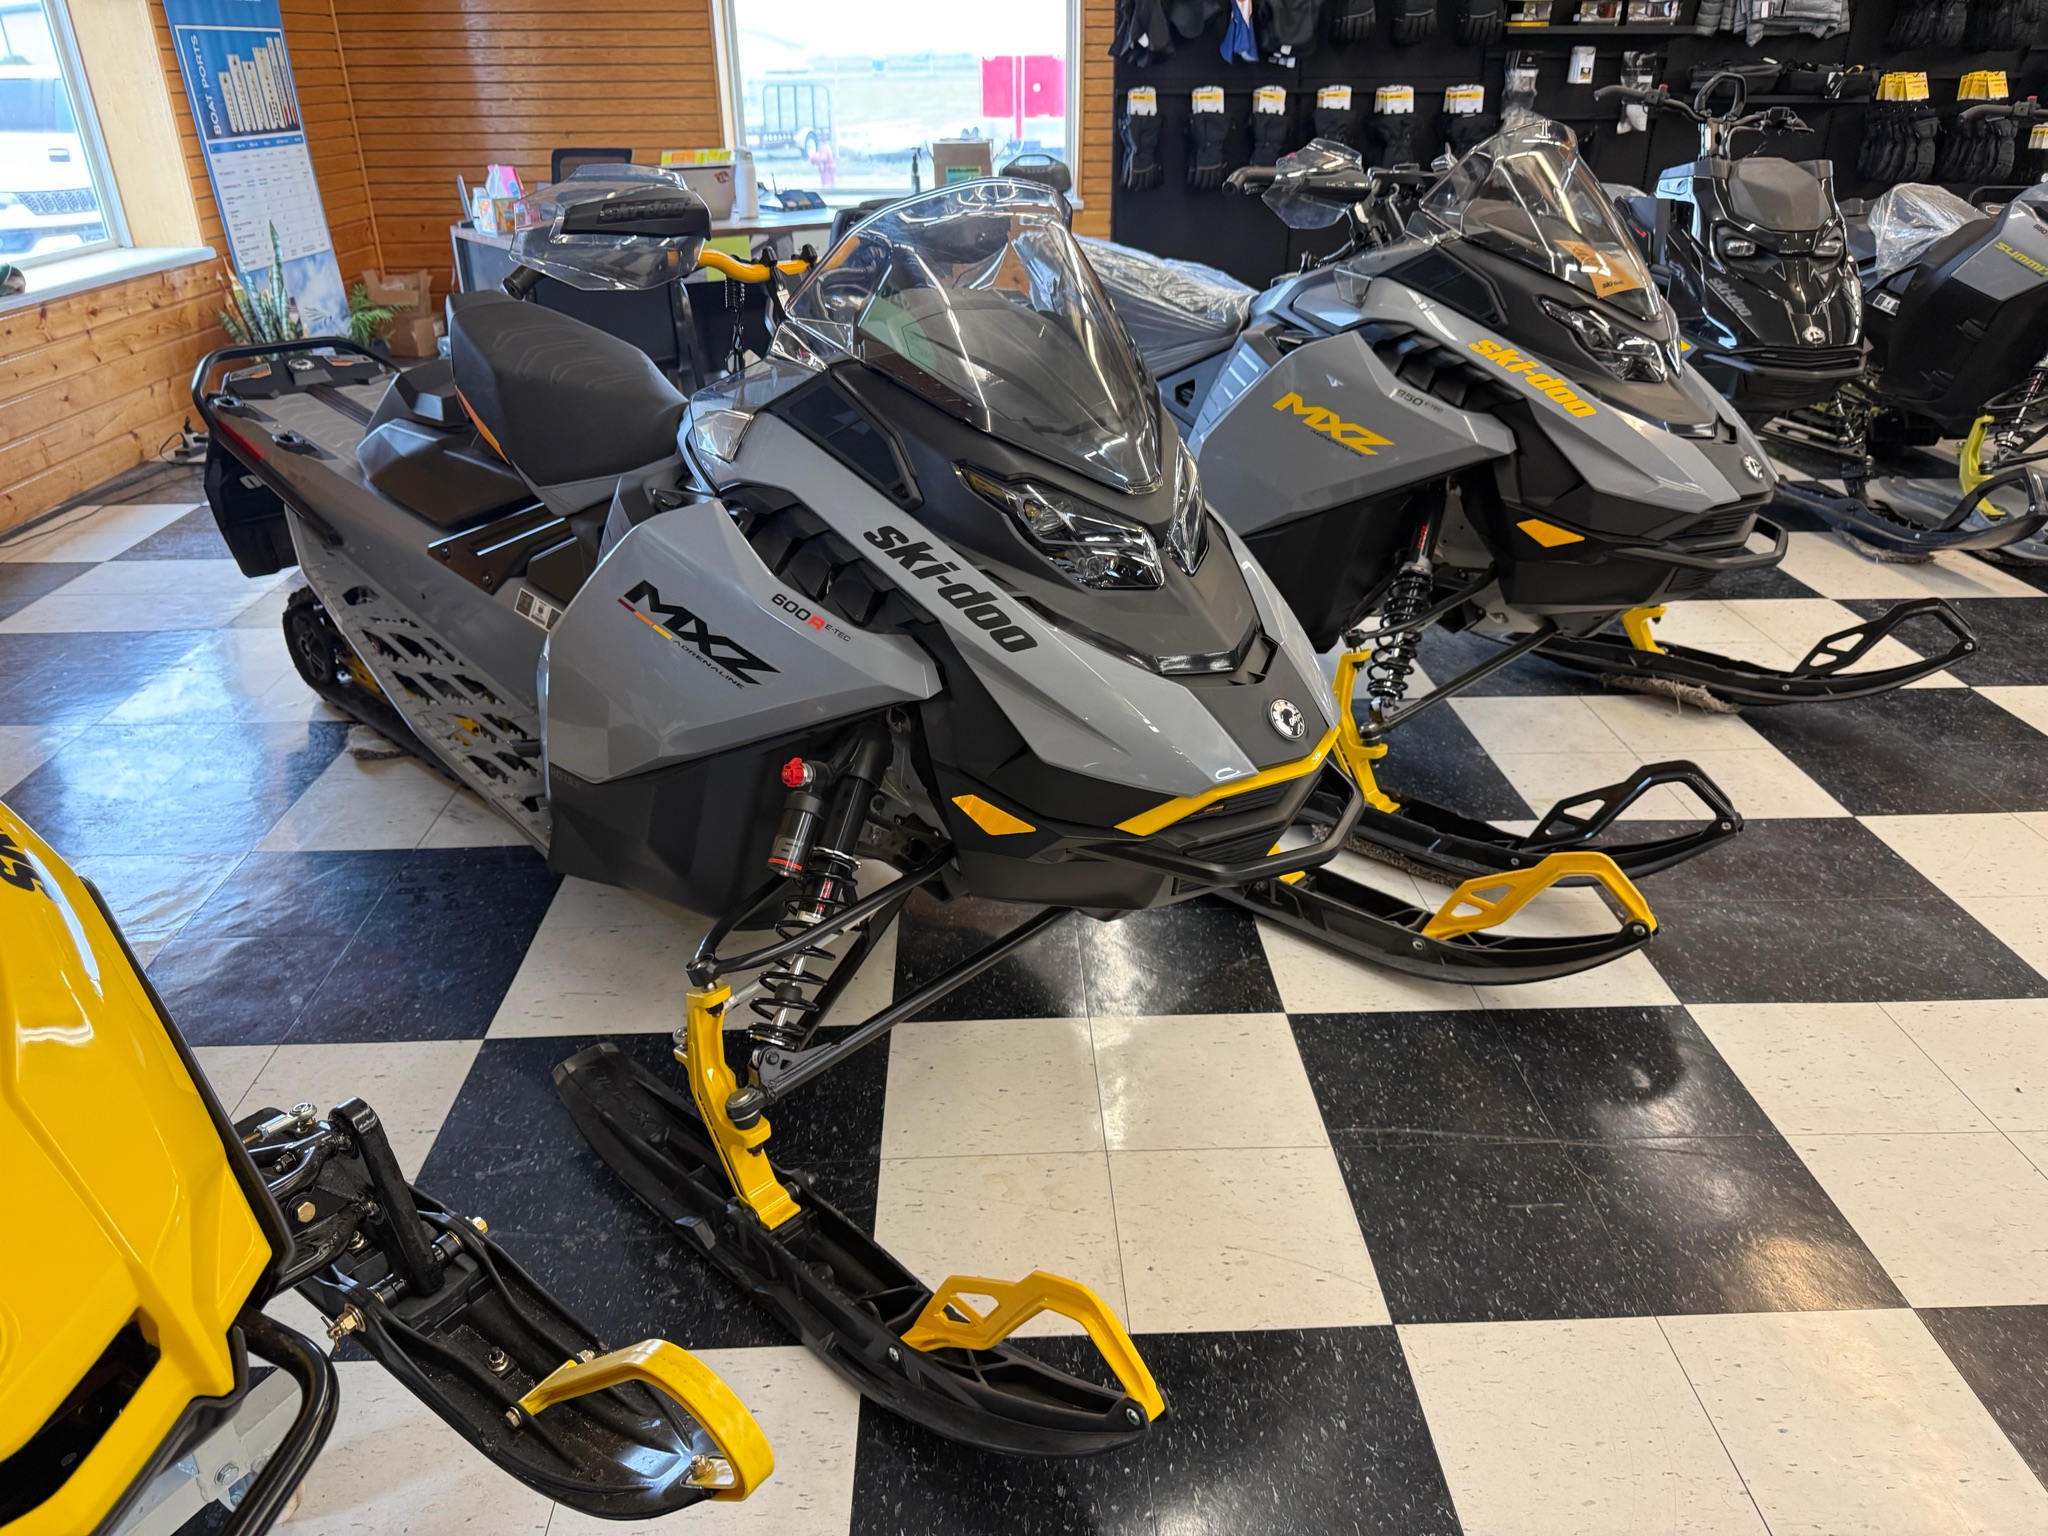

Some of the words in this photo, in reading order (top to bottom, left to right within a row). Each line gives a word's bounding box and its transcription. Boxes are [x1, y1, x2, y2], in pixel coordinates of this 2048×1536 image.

[190, 34, 211, 89] PORTS
[204, 93, 222, 135] BOAT
[1708, 277, 1752, 317] ski-doo
[1468, 339, 1597, 418] ski-doo
[1272, 391, 1396, 456] MXZ
[863, 525, 1038, 653] ski-doo
[623, 579, 782, 686] MXZ
[824, 623, 851, 643] E-TEC
[673, 640, 746, 690] ADRENALINE
